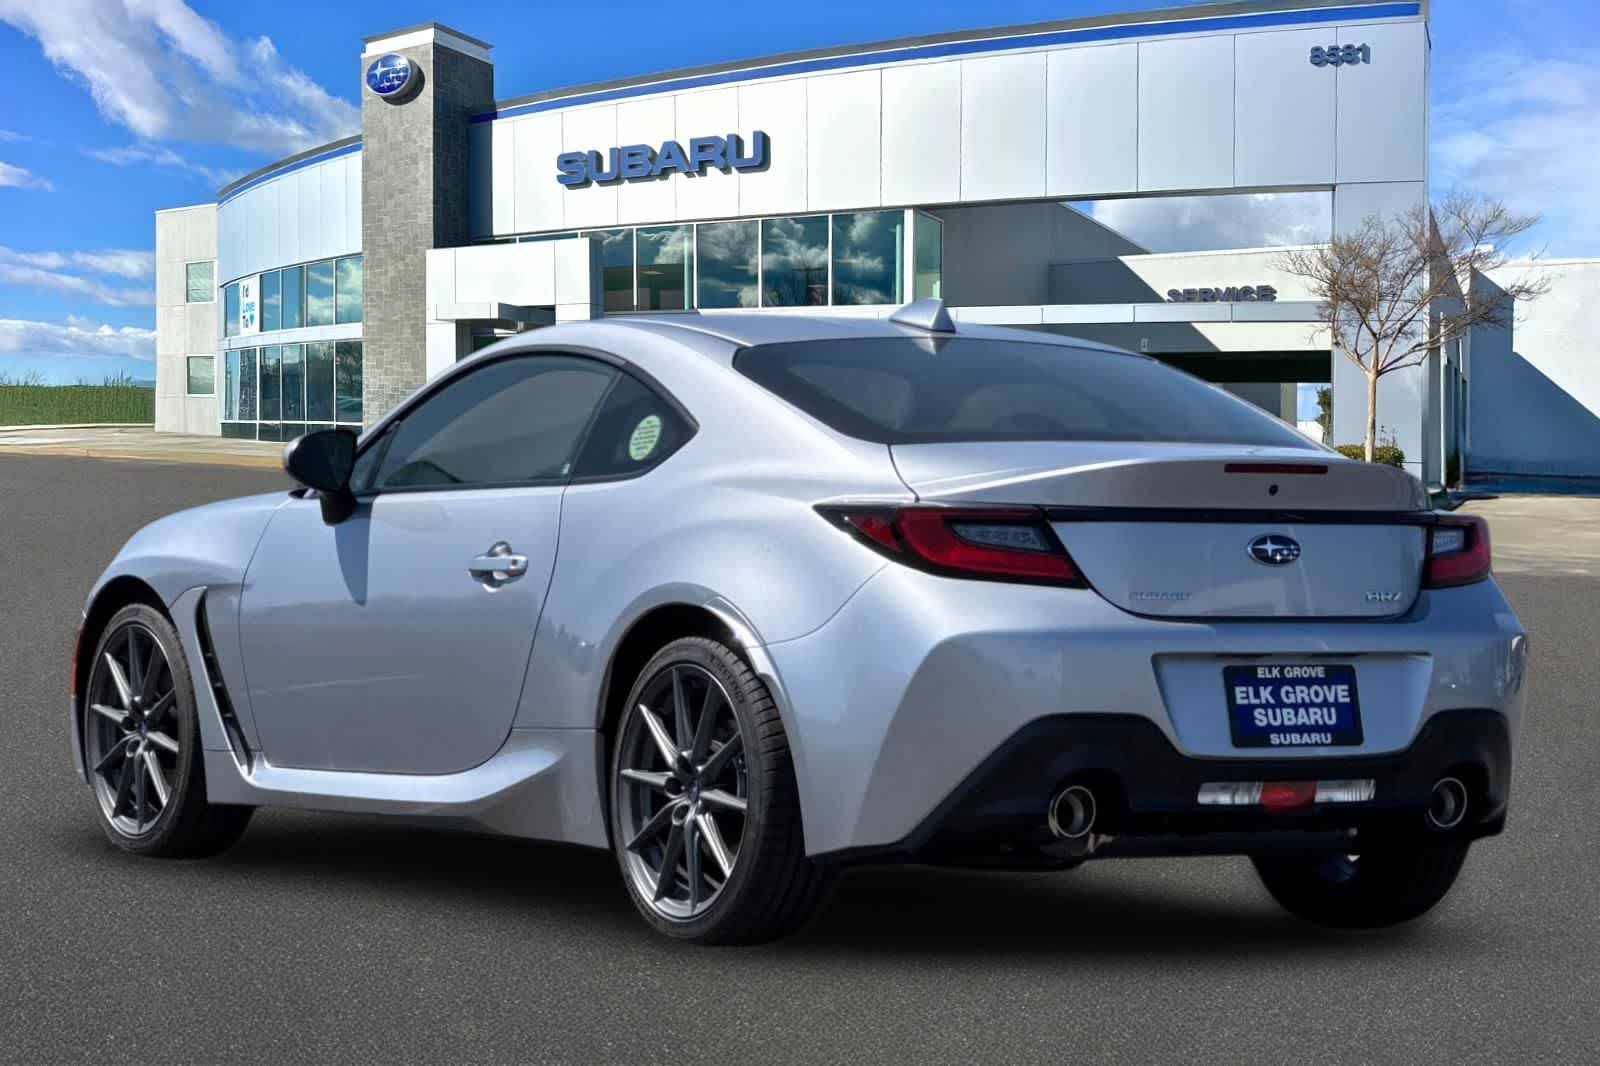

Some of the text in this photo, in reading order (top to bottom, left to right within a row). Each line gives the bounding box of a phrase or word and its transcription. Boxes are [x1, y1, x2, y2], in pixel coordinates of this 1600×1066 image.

[557, 130, 770, 189] SUBARU
[1167, 285, 1277, 302] SERVICE
[1257, 666, 1325, 678] ELK GROVE
[1234, 685, 1350, 704] ELK GROVE
[1253, 707, 1337, 726] SUBARU
[1270, 733, 1332, 745] SUBARU
